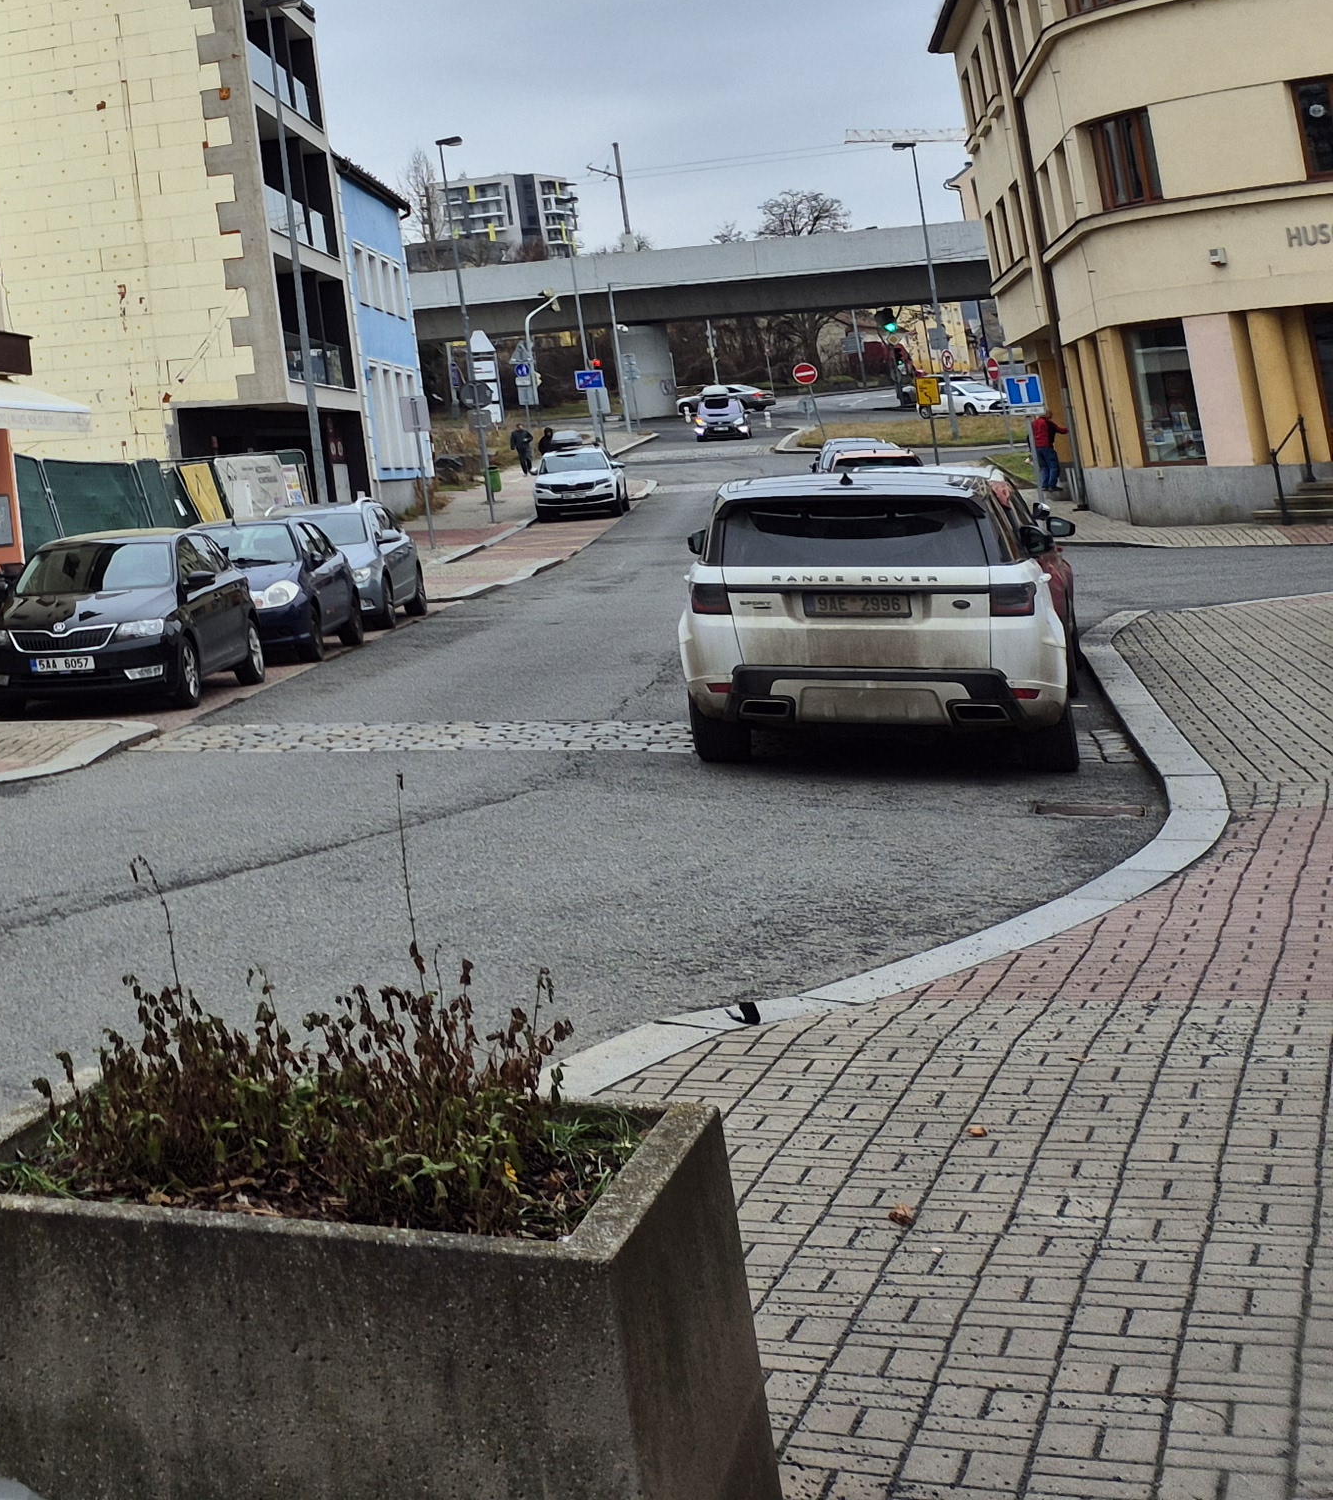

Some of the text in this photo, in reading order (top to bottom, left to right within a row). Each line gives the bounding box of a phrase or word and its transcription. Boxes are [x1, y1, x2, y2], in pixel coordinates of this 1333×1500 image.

[1285, 223, 1333, 248] HUS
[818, 597, 902, 612] 9AE 2996
[38, 657, 89, 670] 5AA 6057
